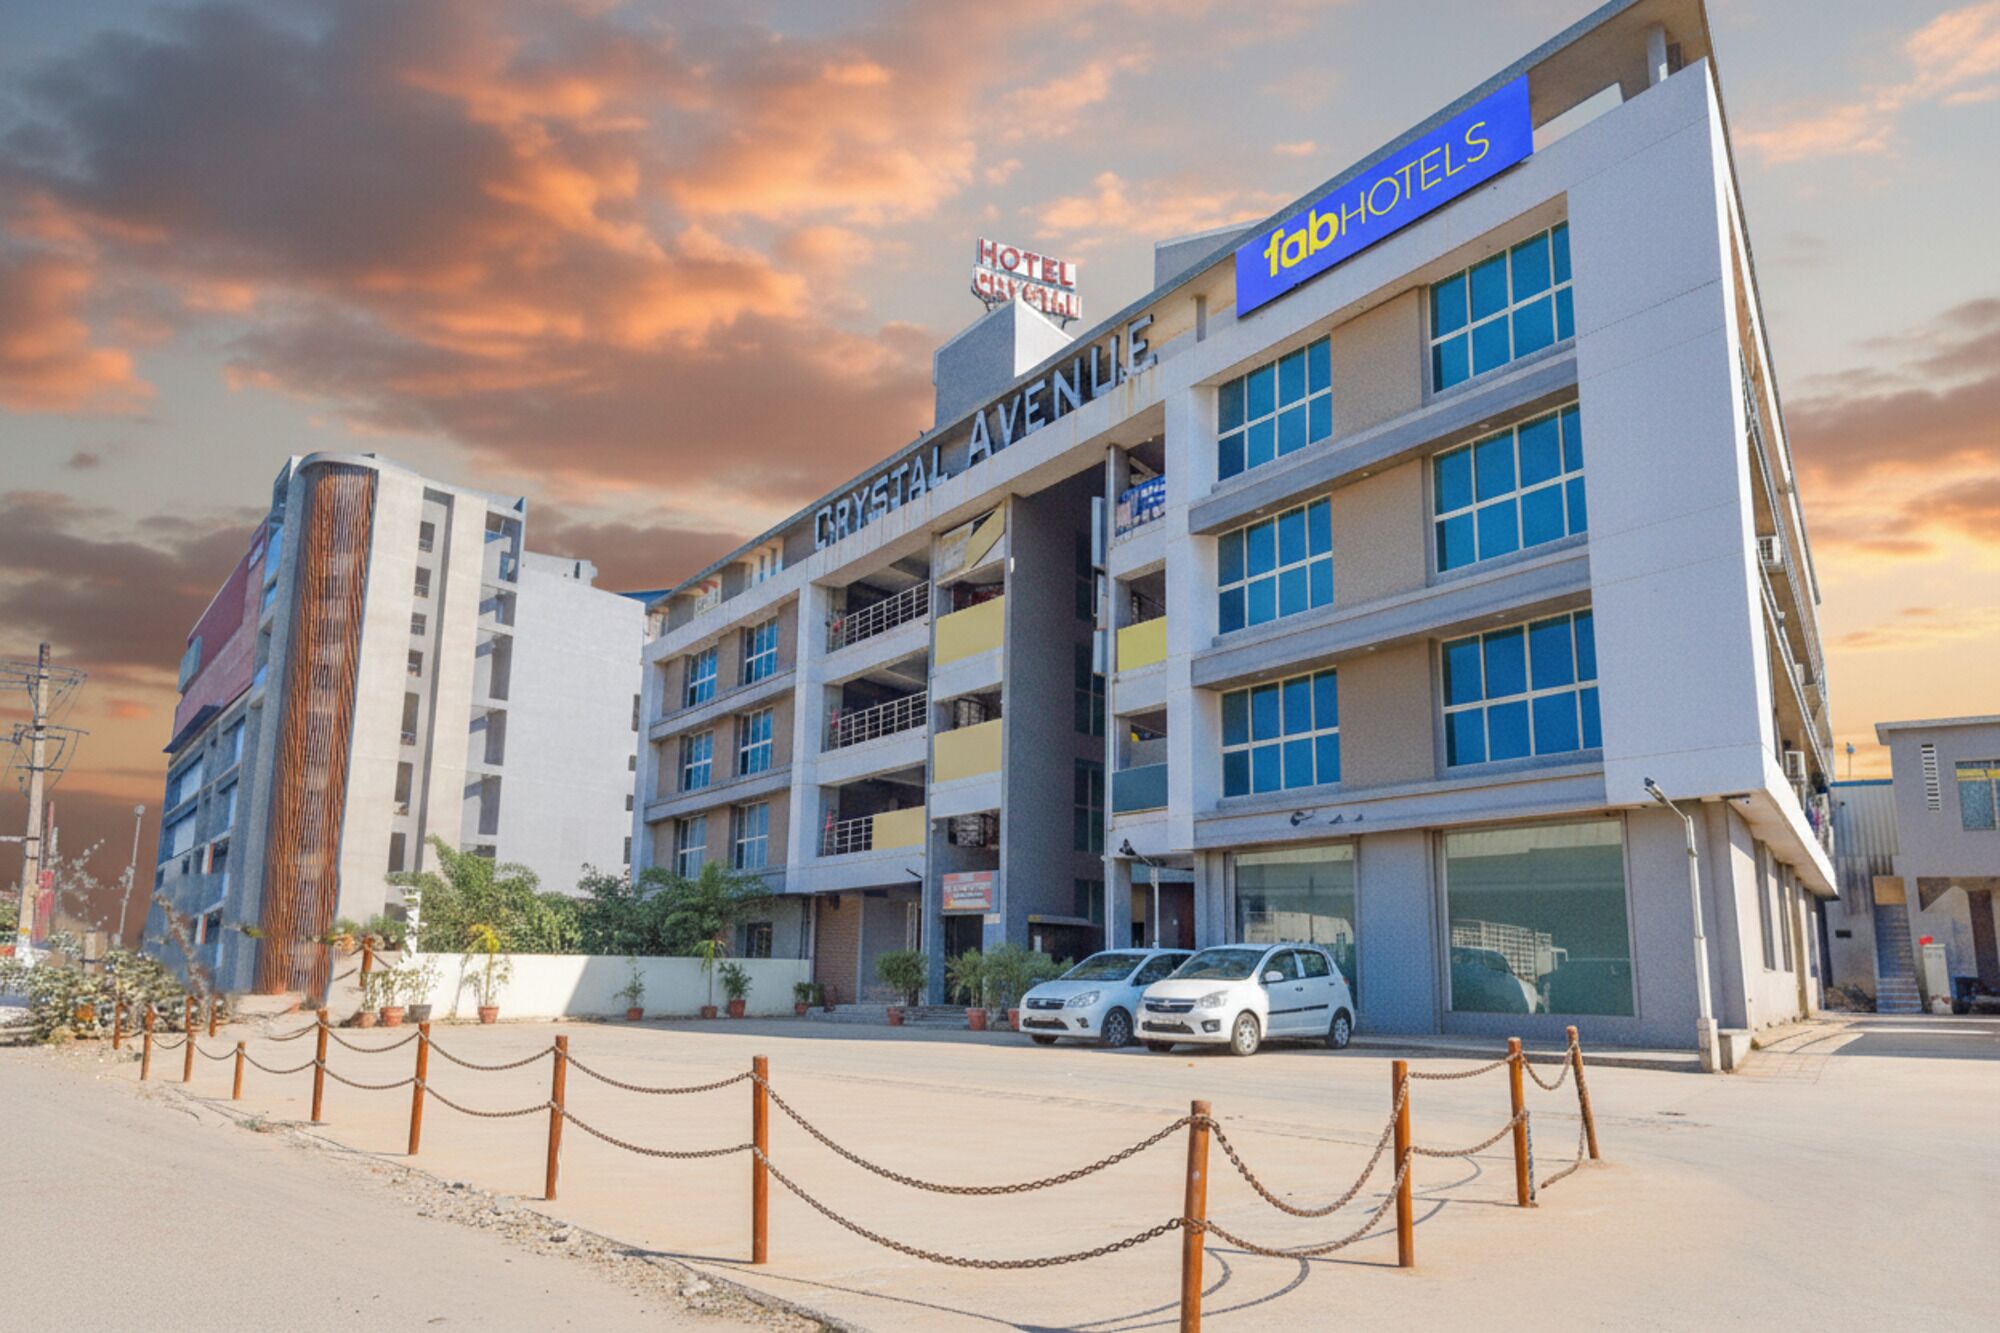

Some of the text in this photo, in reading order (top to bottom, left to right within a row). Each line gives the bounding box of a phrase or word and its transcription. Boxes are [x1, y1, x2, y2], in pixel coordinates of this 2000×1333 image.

[979, 238, 1075, 286] HOTEL
[815, 315, 1157, 550] CRYSTAL AVENUE
